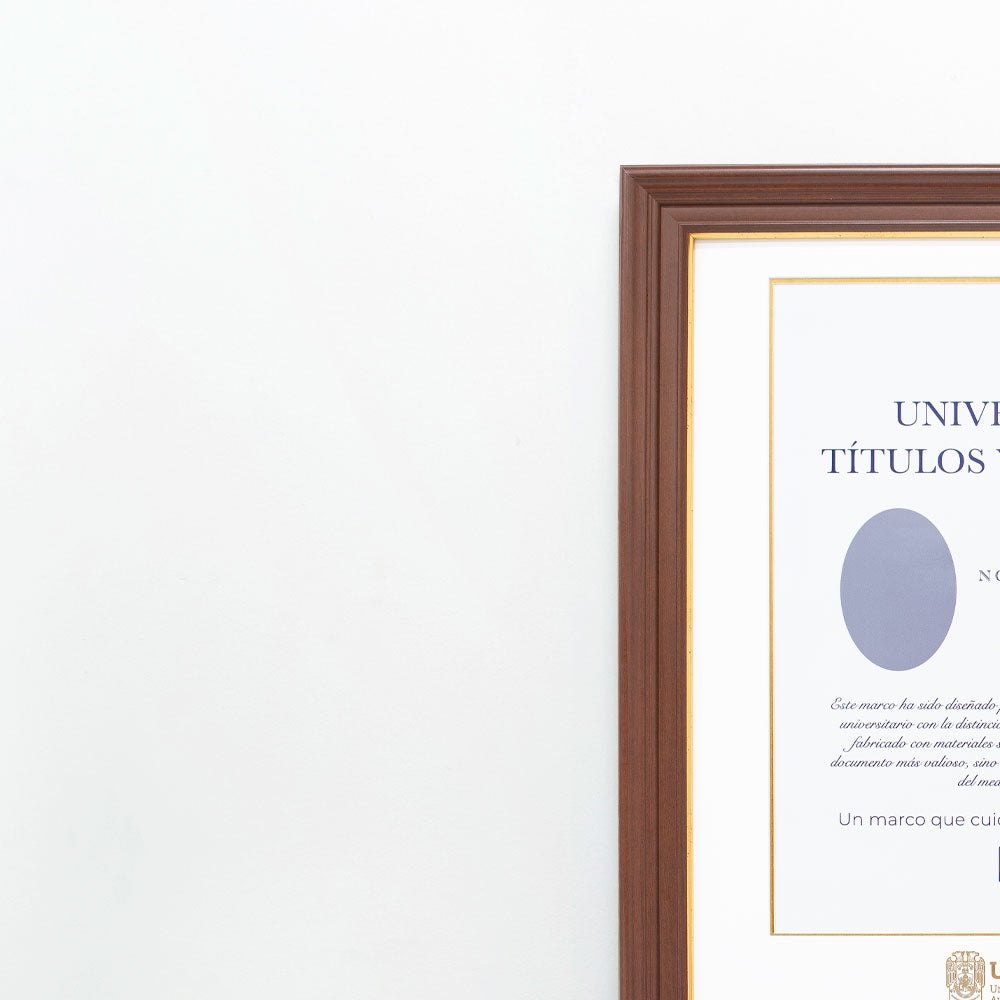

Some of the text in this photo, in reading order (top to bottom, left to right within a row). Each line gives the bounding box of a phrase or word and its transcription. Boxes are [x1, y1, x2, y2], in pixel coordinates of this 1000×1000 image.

[821, 441, 986, 475] TÍTULOS
[831, 697, 856, 710] Este
[858, 702, 898, 710] marco
[899, 698, 915, 710] ha
[917, 698, 942, 710] sido
[945, 698, 998, 710] diseñado
[839, 719, 914, 729] universitario
[916, 721, 937, 729] con
[940, 717, 953, 729] la
[843, 736, 908, 752] fabricado
[910, 740, 934, 748] con
[934, 736, 995, 748] materiales
[830, 755, 894, 767] documento
[896, 757, 921, 767] más
[924, 755, 969, 768] valioso,
[973, 758, 999, 767] sino
[958, 774, 978, 787] del
[839, 813, 863, 826] Un
[869, 815, 926, 826] marco
[931, 815, 965, 829] que
